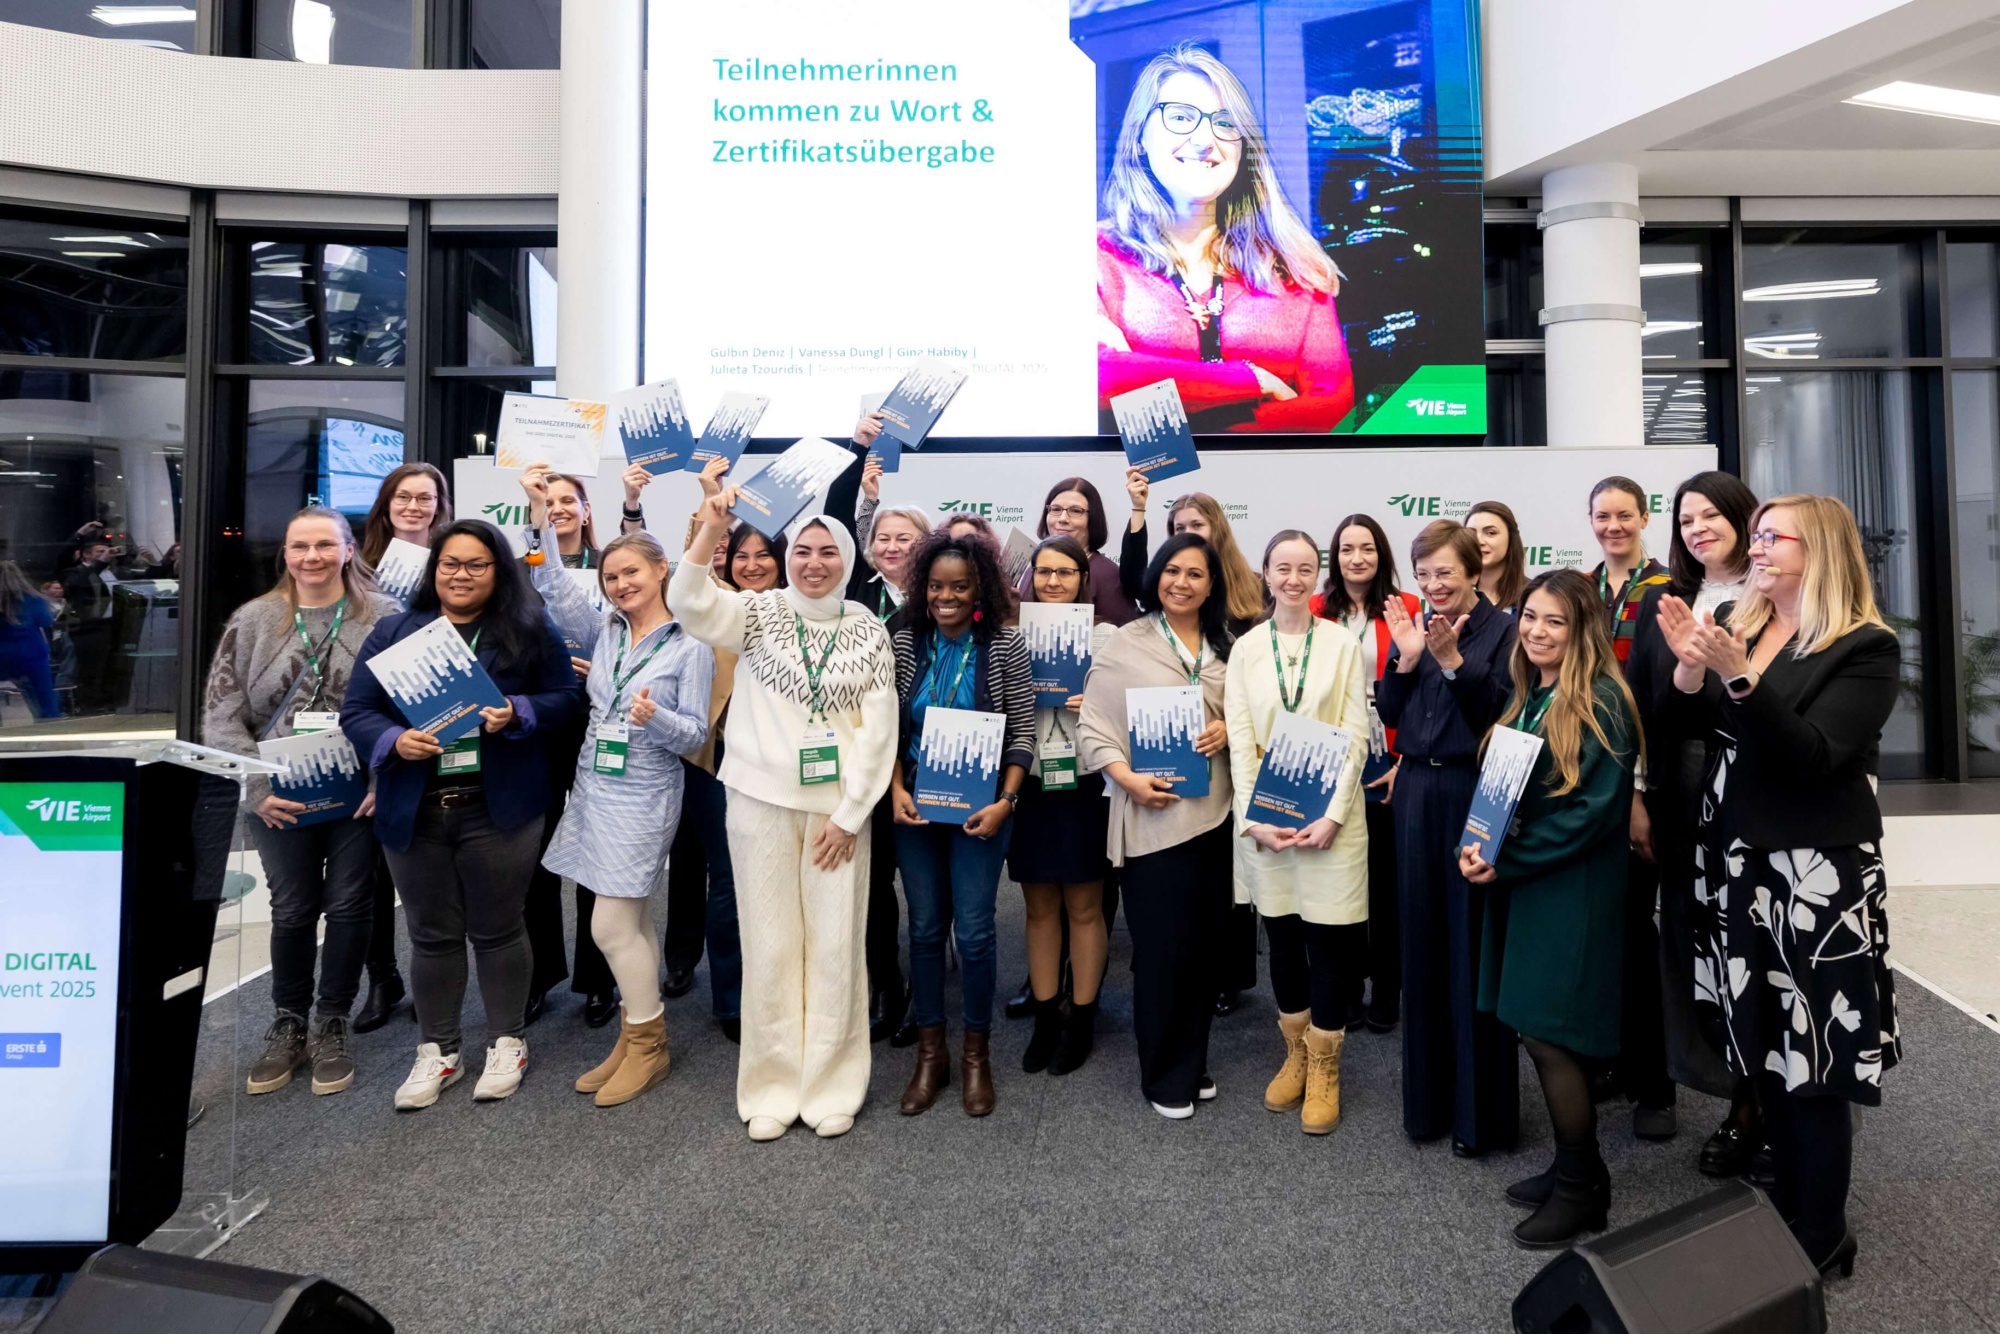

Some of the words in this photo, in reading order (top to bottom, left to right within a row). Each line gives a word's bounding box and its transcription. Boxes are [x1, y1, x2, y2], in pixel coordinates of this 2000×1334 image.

[712, 58, 957, 81] Teilnehmerinnen
[713, 98, 839, 122] kommen
[849, 105, 880, 122] zu
[890, 99, 962, 122] Wort
[971, 98, 995, 122] &
[712, 138, 996, 169] Zertifikatsübergabe
[799, 347, 846, 358] Vanessa
[850, 347, 884, 360] Dungl
[927, 347, 968, 359] Habiby
[710, 363, 748, 375] Julieta
[752, 363, 804, 375] Tzouridis
[1416, 400, 1446, 416] VIE
[515, 417, 591, 430] TEILNAHMEZERTIFIKAT
[996, 505, 1024, 513] Vienna
[1400, 496, 1441, 517] VIE
[1444, 499, 1471, 507] Vienna
[996, 514, 1024, 524] Airport
[1226, 512, 1248, 520] irport
[1524, 546, 1552, 566] IE
[1556, 549, 1583, 557] Vienna
[1555, 557, 1583, 566] Airport
[1255, 794, 1275, 805] WISSEN
[40, 800, 82, 822] VIE
[83, 804, 112, 812] Vienna
[82, 813, 112, 823] Airport
[5, 953, 97, 971] DIGITAL
[0, 982, 44, 998] vent
[50, 981, 96, 998] 2025
[6, 1044, 36, 1053] ERSTE
